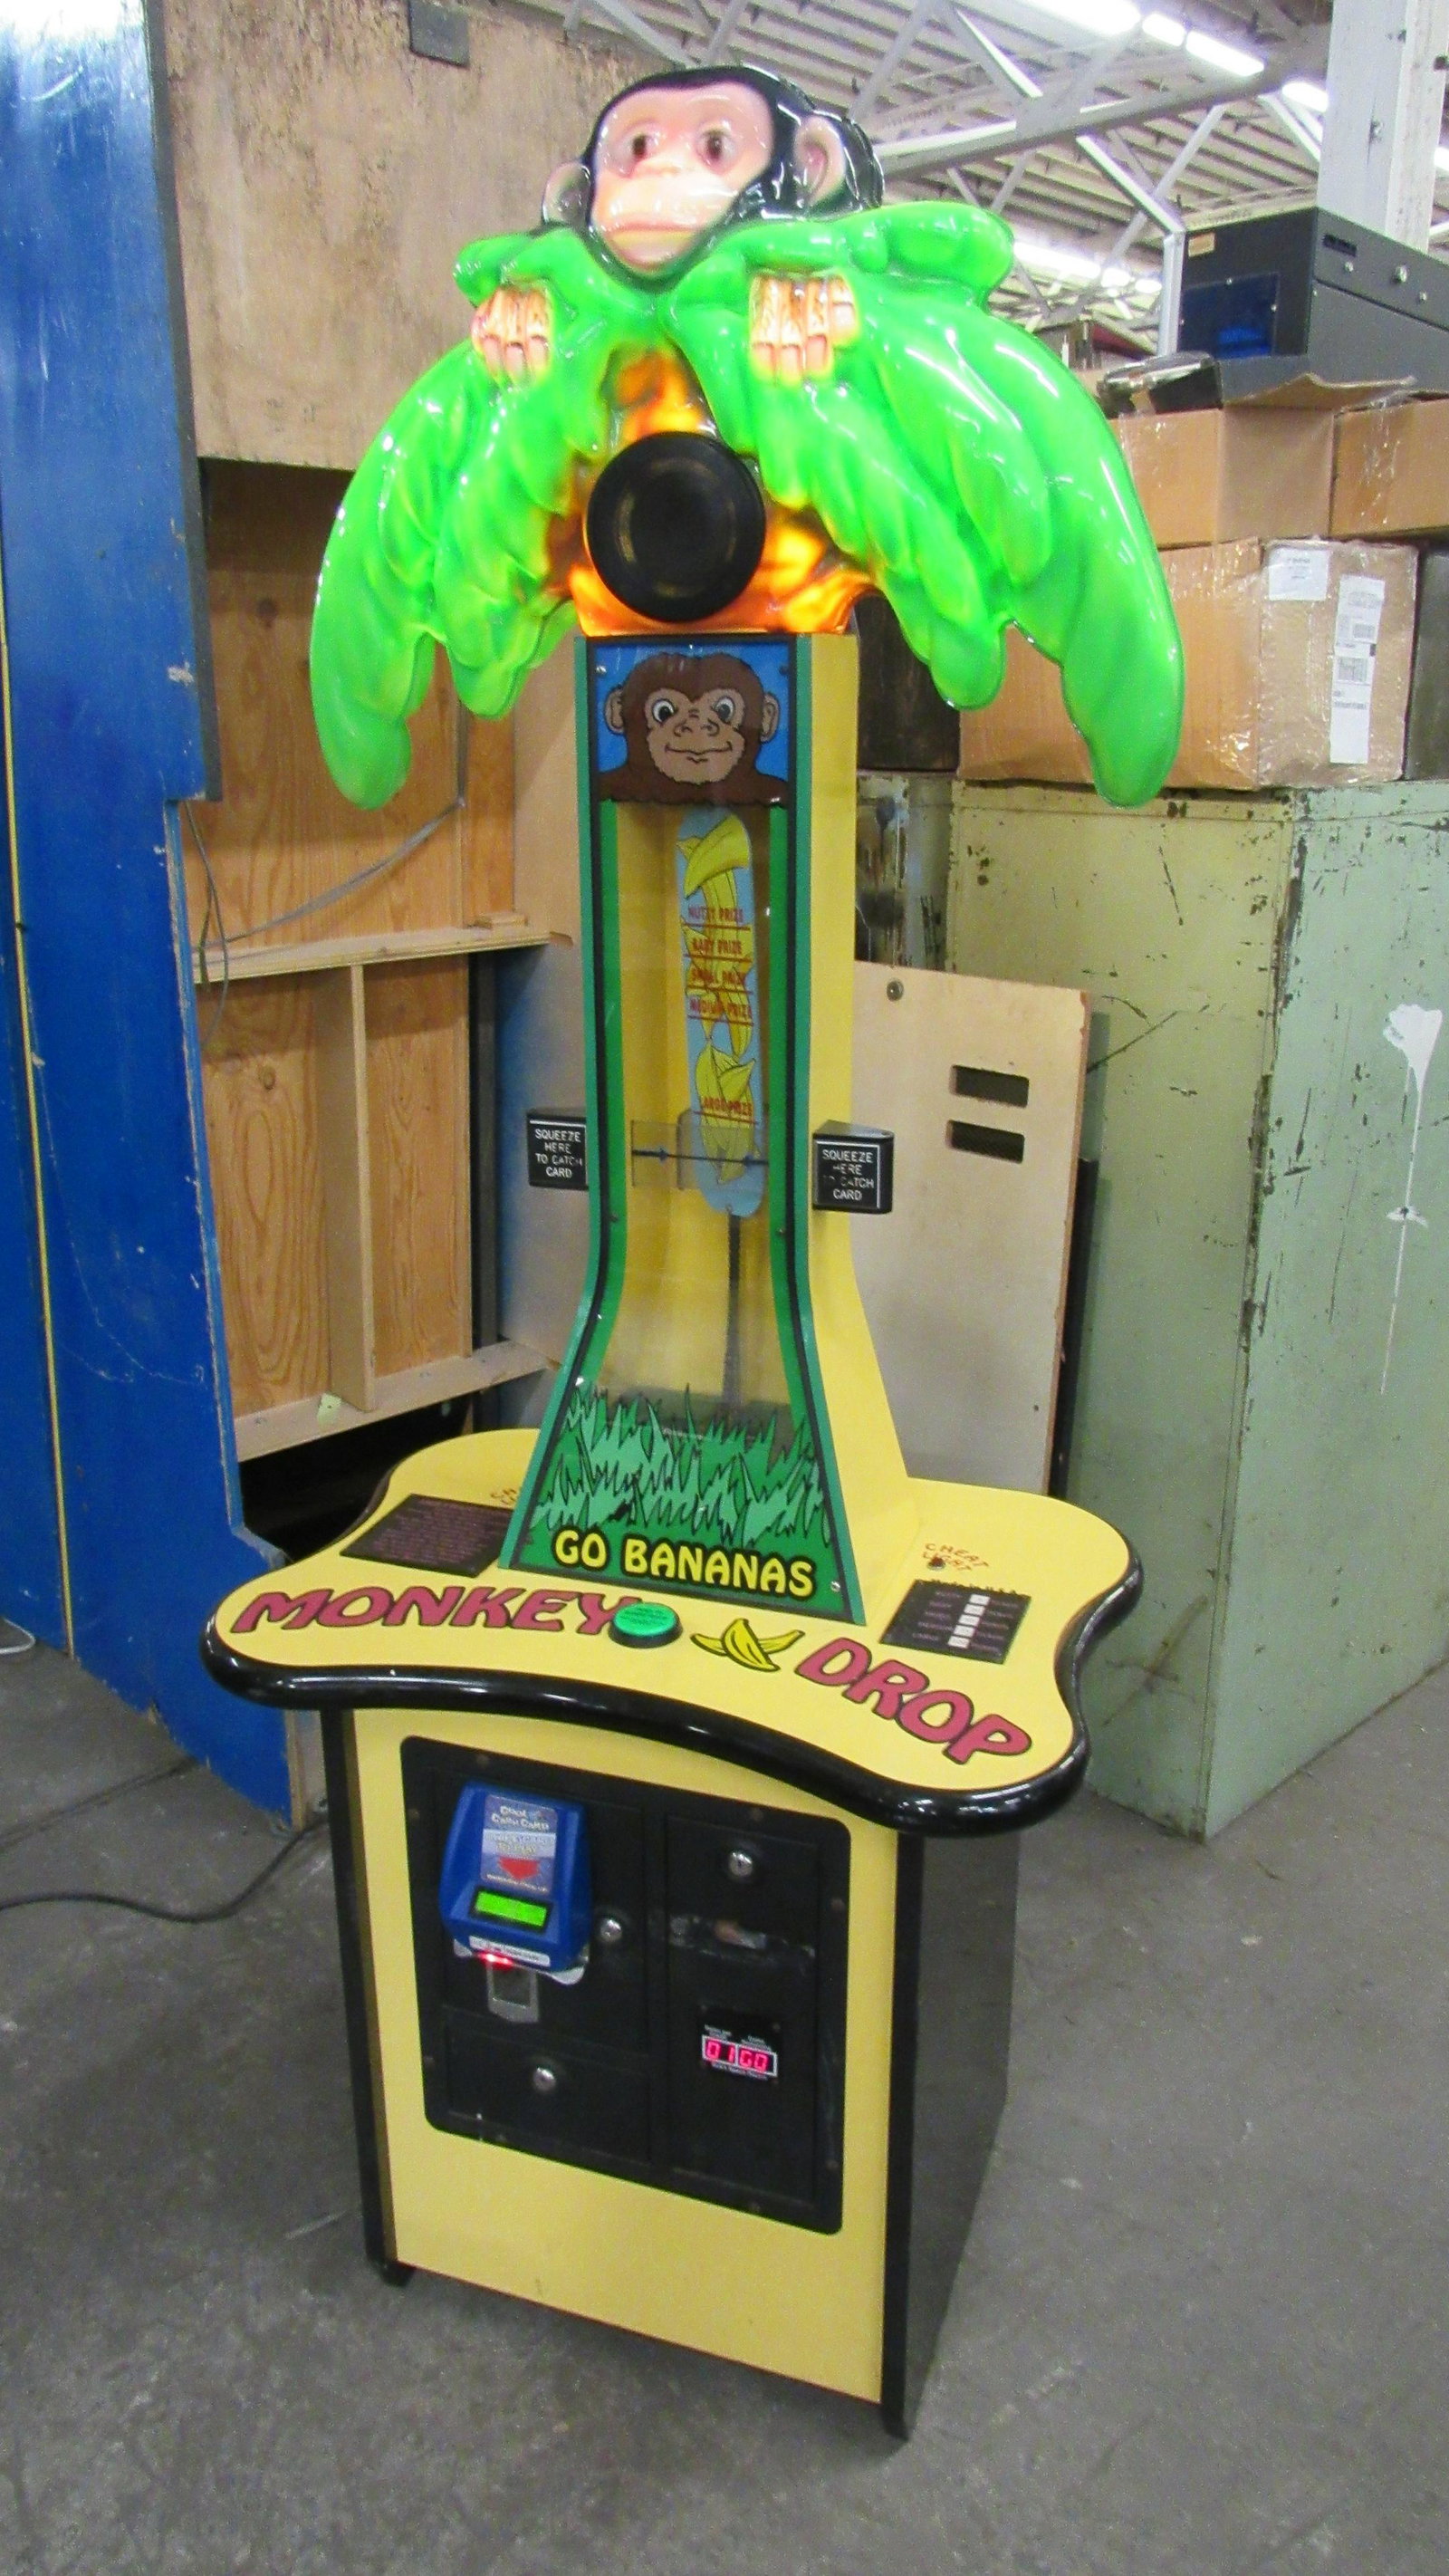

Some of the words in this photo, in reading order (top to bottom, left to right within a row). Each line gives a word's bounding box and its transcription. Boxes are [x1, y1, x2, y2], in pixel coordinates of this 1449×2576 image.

[719, 908, 744, 923] PRIZE
[717, 938, 742, 955] PRIZE
[723, 970, 746, 986] PRIZE
[534, 1128, 581, 1143] SQUEEZE
[544, 1141, 572, 1155] HERE
[535, 1152, 549, 1165] TO
[822, 1149, 874, 1164] SQUEEZE
[545, 1166, 573, 1178] CARD
[833, 1163, 863, 1176] HERE
[833, 1188, 863, 1201] CARD
[925, 1543, 989, 1567] CHEAT
[553, 1527, 609, 1570] GO
[622, 1535, 815, 1599] BANANAS
[230, 1585, 642, 1635] MONKEY
[794, 1637, 1032, 1764] DROP
